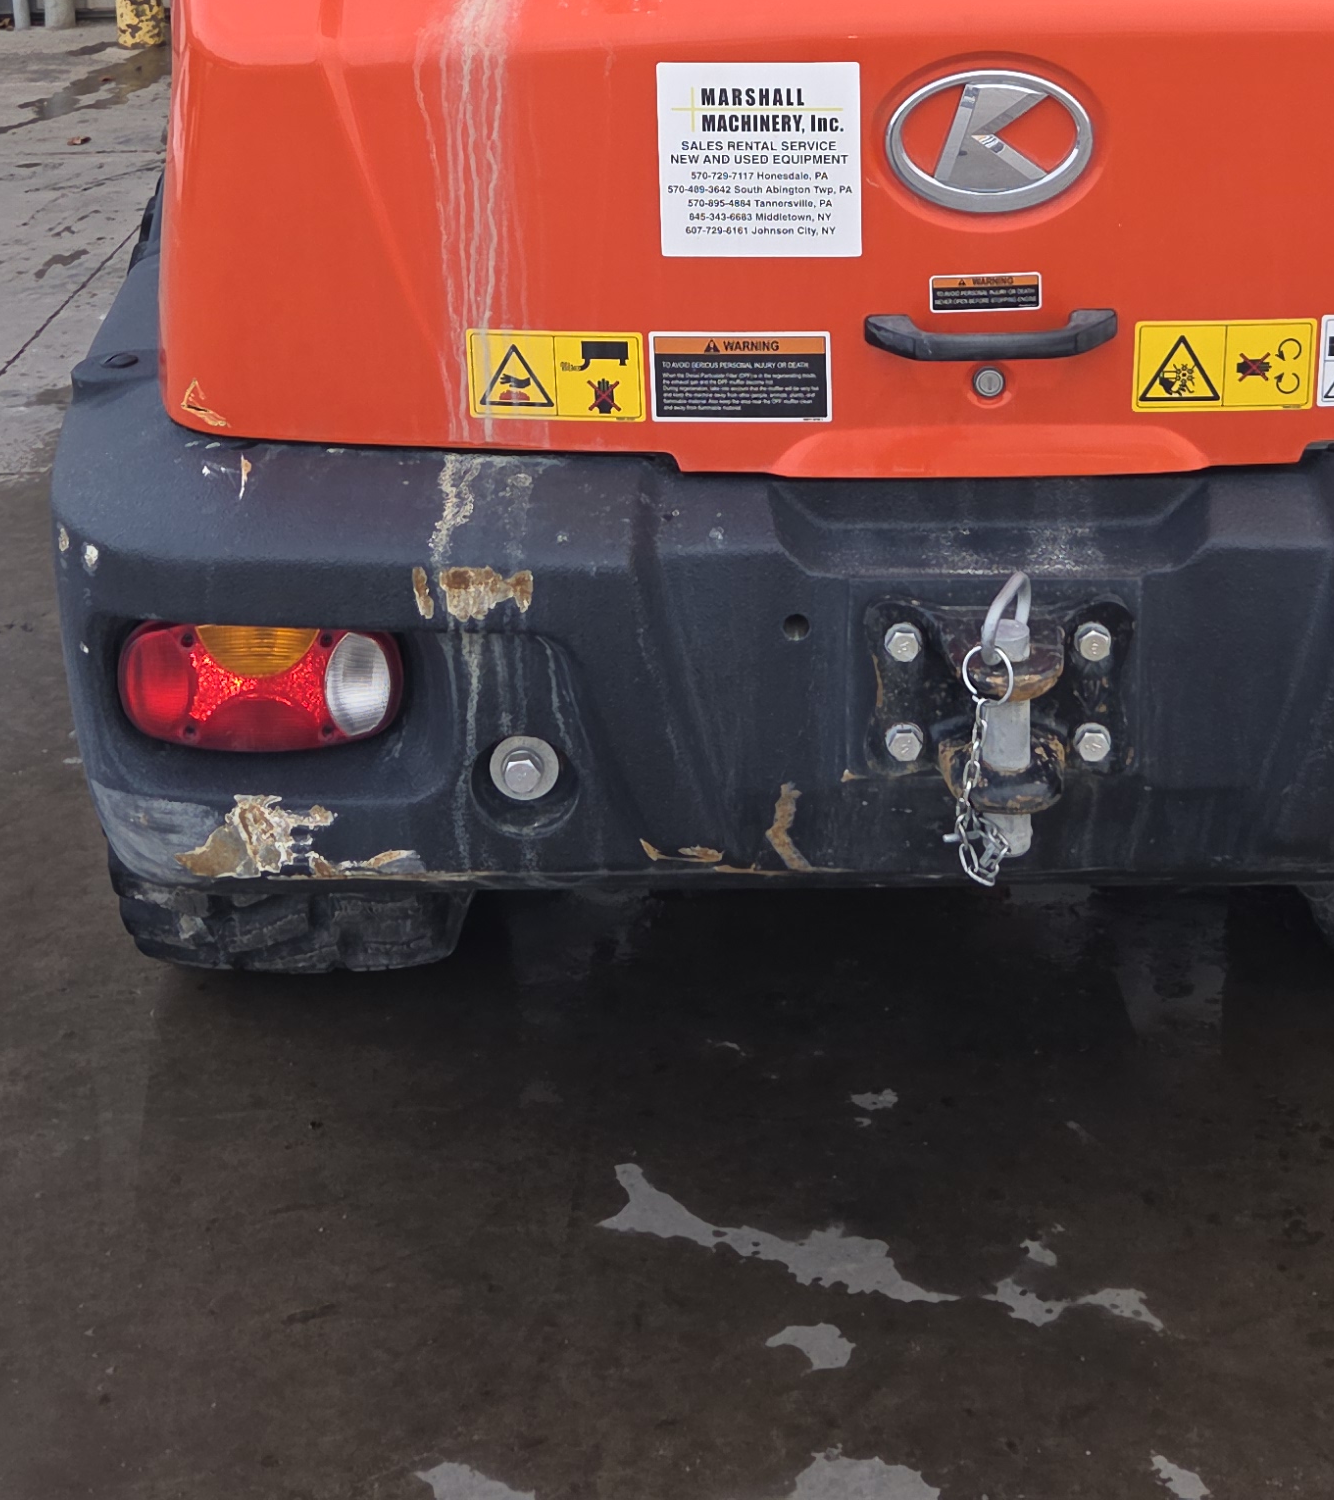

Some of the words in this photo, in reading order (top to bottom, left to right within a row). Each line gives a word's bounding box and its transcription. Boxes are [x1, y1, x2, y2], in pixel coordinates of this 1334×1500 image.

[701, 88, 805, 106] MARSHALL
[702, 114, 806, 134] MACHINERY,
[811, 114, 845, 132] Inc.
[681, 140, 724, 151] SALES
[728, 140, 777, 151] RENTAL
[781, 140, 837, 151] SERVICE
[670, 154, 700, 164] NEW
[703, 154, 730, 164] AND
[734, 154, 768, 164] USED
[772, 154, 849, 165] EQUIPMENT
[691, 171, 754, 180] 570-729-7117
[757, 171, 812, 181] Honesdale,
[814, 171, 828, 180] PA
[734, 185, 763, 194] South
[765, 185, 811, 196] Abington
[813, 185, 837, 196] Twp,
[839, 185, 853, 194] PA
[754, 198, 816, 209] Tannersville,
[819, 199, 833, 208] PA
[755, 212, 815, 222] Middletown,
[817, 212, 832, 221] NY
[751, 226, 795, 235] Johnson
[797, 226, 819, 237] City,
[821, 226, 836, 235] NY
[972, 277, 1014, 286] WARNING
[723, 340, 780, 352] WARNING
